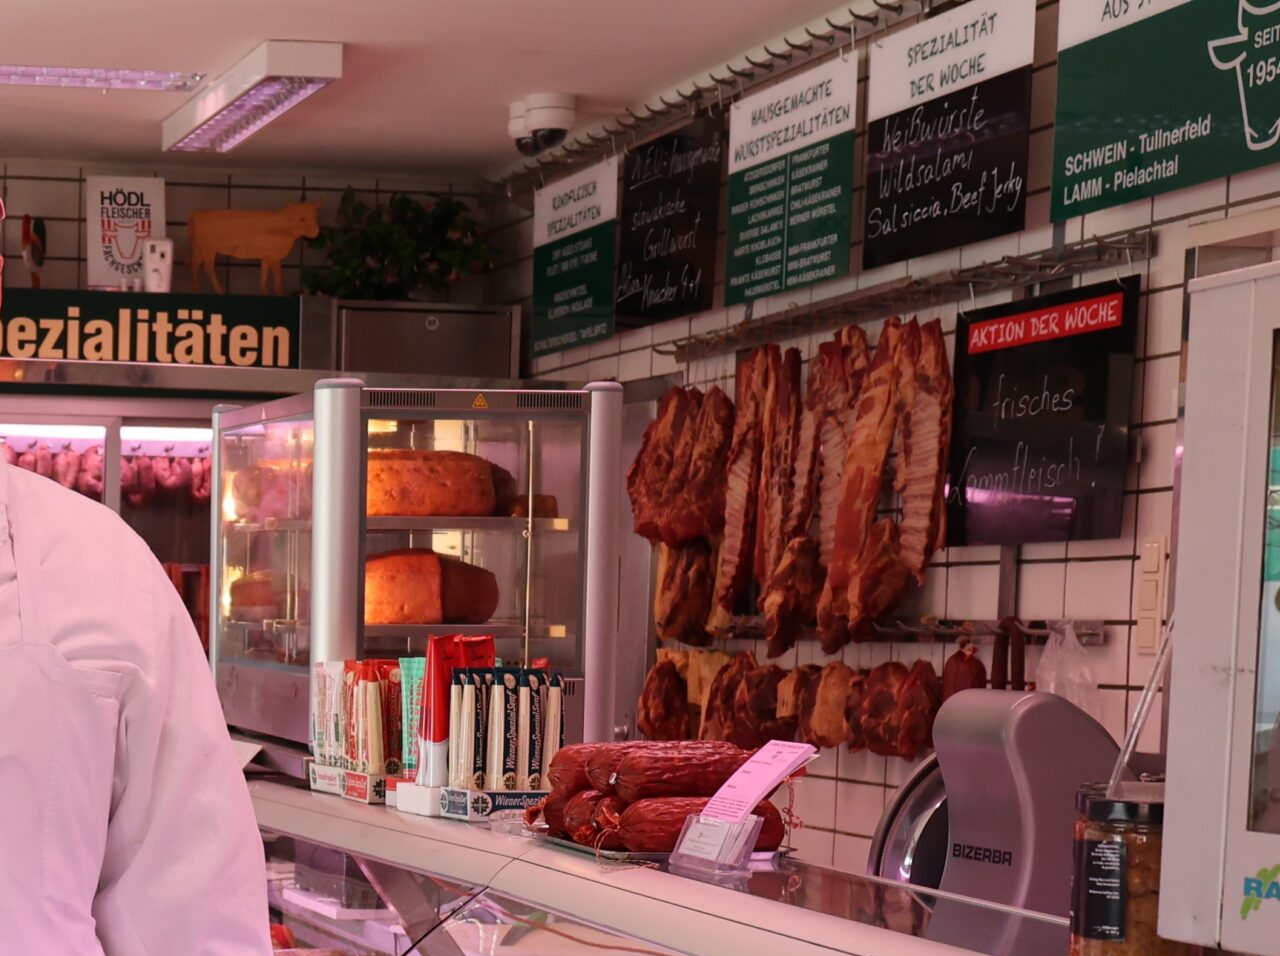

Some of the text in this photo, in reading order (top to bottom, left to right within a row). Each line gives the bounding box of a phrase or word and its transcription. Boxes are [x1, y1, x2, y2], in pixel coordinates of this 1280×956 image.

[907, 12, 998, 67] SPEZIALITÄT
[1254, 25, 1280, 49] SEIT
[910, 52, 986, 99] DER WOCHE
[751, 79, 833, 128] HAUSGEMACHTE
[734, 103, 851, 163] WURSTSPEZIALITÄTEN
[1064, 140, 1127, 177] SCHWEIN
[1139, 113, 1212, 155] Tullnerfeld
[100, 188, 151, 207] HÖDL
[879, 147, 973, 199] Wildsalami
[950, 170, 987, 215] Beef
[986, 161, 1023, 214] Jerky
[1063, 178, 1103, 206] LAMM
[1113, 155, 1179, 191] Pielachtal
[101, 206, 151, 219] FLEISCHER
[102, 245, 144, 274] FACHGESCH
[971, 300, 1120, 347] AKTION DER WOCHE
[993, 373, 1075, 429] frisches
[952, 843, 1013, 867] BIZERBA
